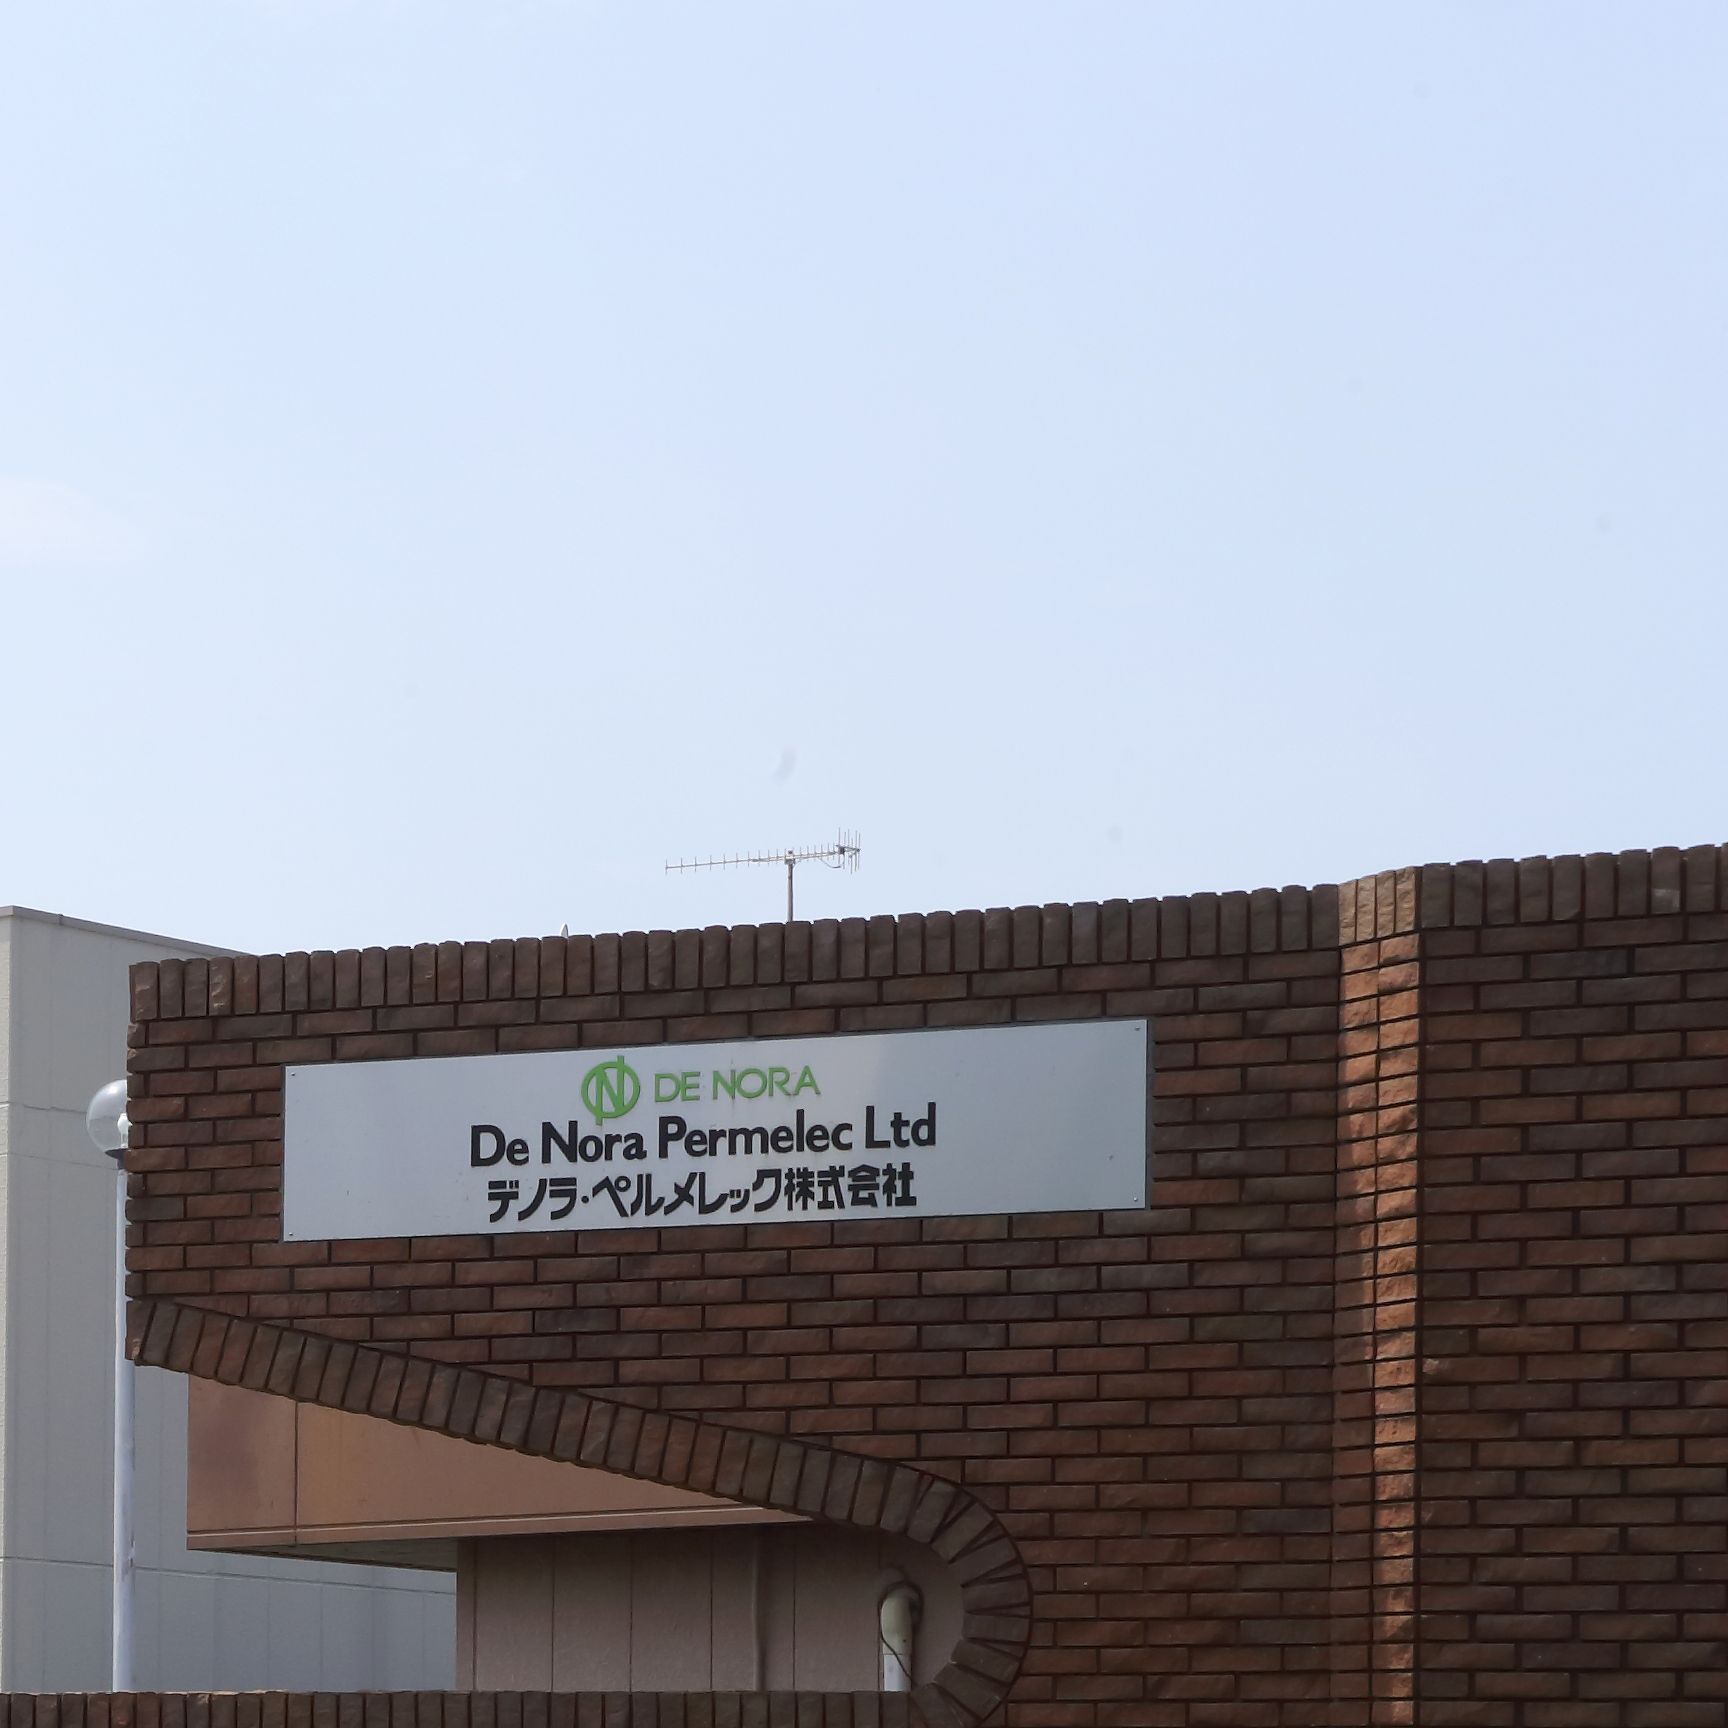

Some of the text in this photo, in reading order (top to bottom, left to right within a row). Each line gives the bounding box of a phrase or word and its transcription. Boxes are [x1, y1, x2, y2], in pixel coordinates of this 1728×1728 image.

[654, 1071, 701, 1103] DE
[712, 1065, 821, 1100] NORA
[471, 1102, 937, 1168] De Nora Permelec Ltd
[488, 1162, 917, 1223] デノラ・ペルメレック株式会社
